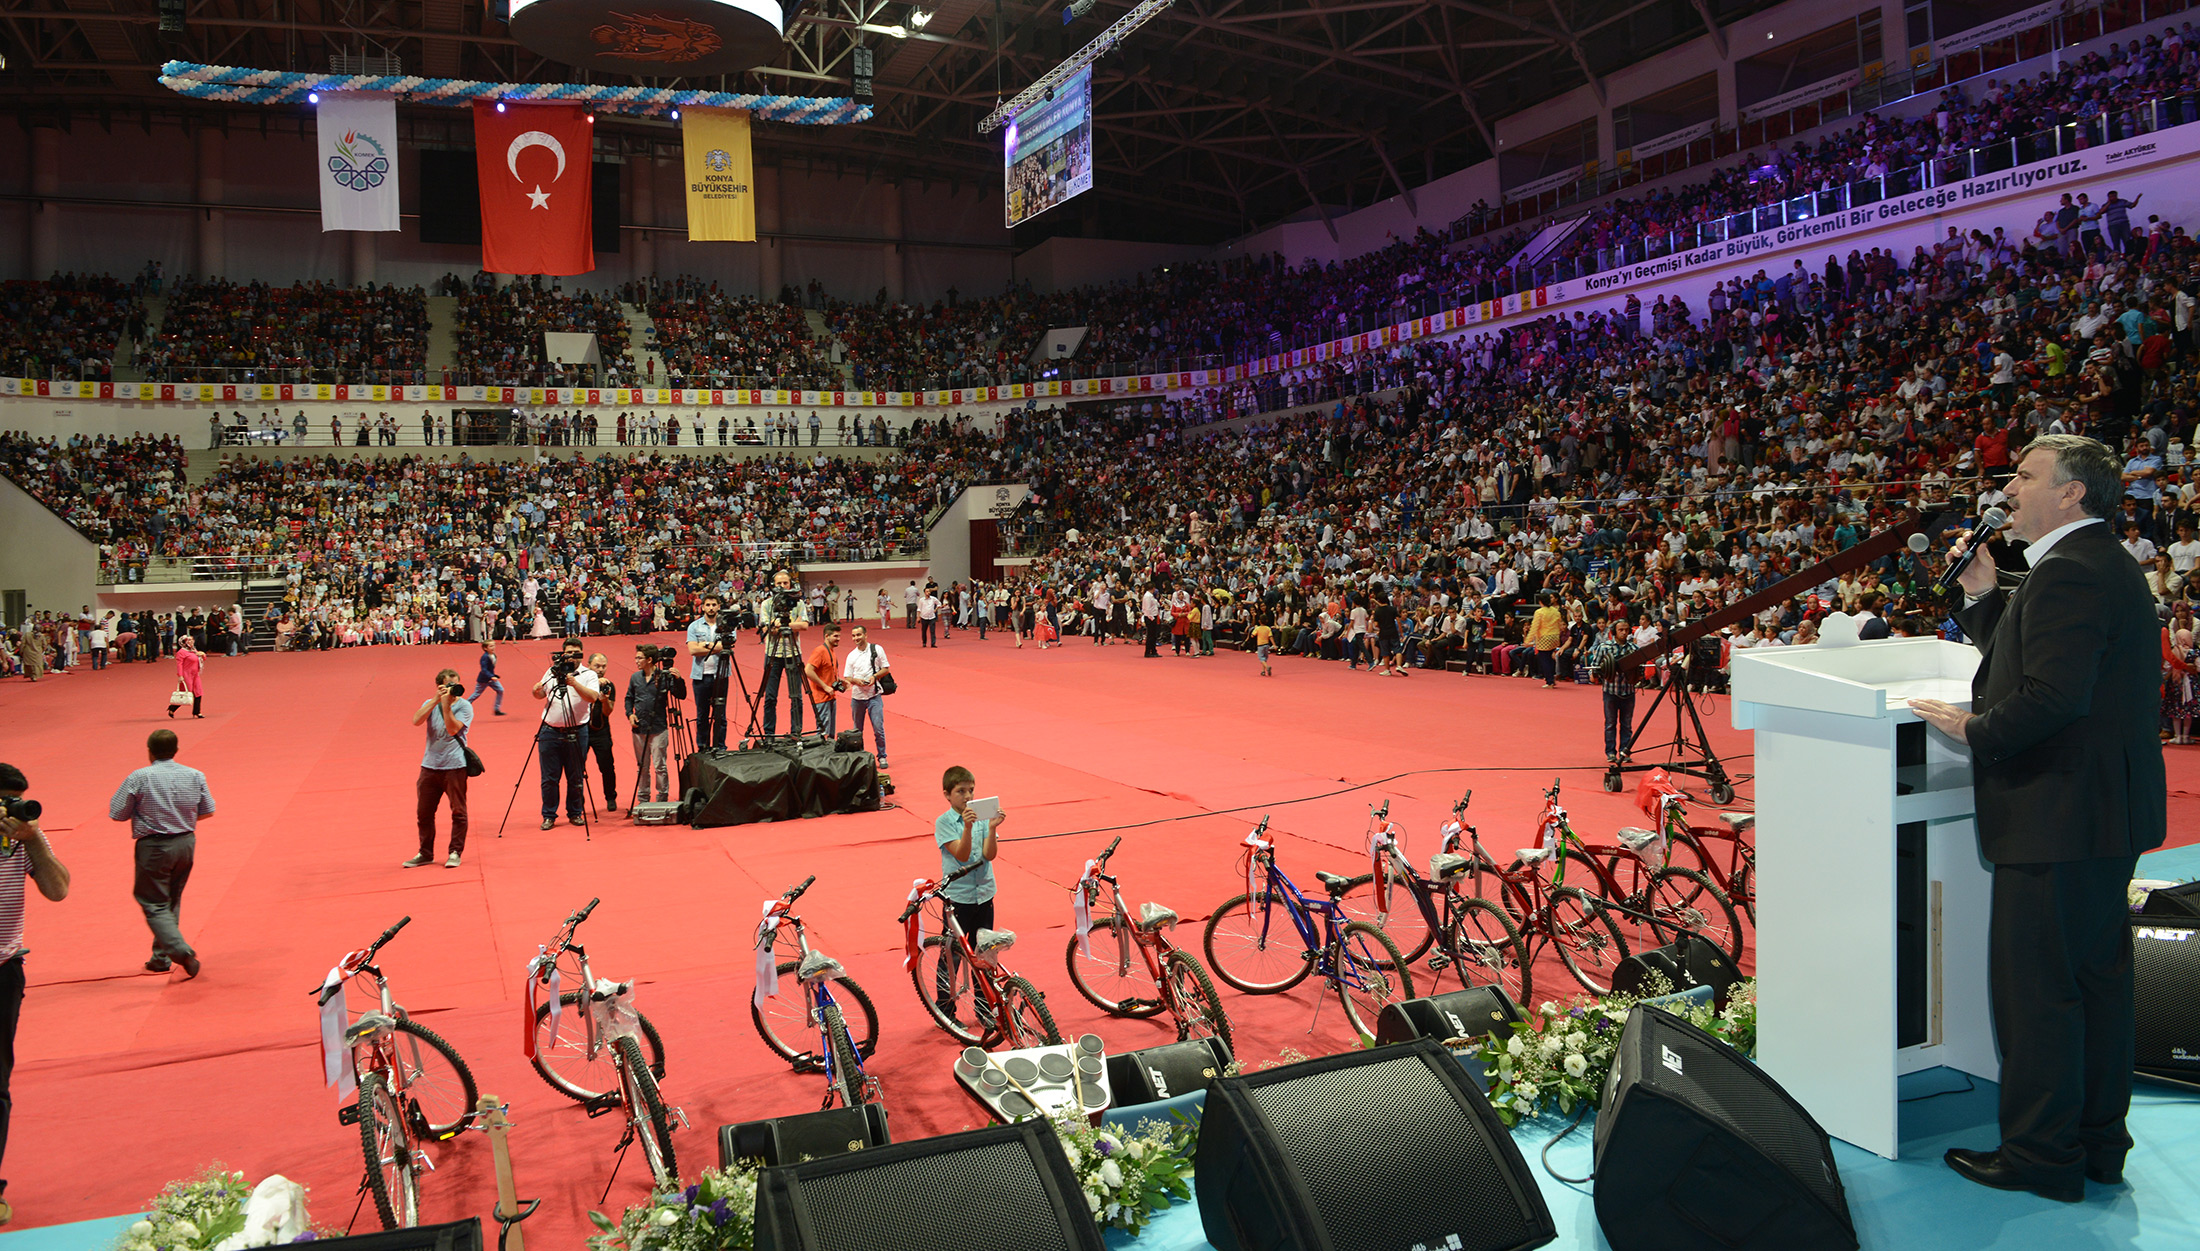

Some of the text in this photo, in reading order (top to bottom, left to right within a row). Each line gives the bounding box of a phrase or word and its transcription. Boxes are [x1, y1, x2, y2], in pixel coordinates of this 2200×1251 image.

[691, 182, 748, 193] BÜYÜKŞEHİR
[1635, 257, 1682, 277] Geçmişi
[1685, 247, 1723, 266] Kadar
[1726, 234, 1773, 257] Büyük,
[1777, 214, 1846, 244] Görkemli
[1850, 209, 1874, 226] Bir
[1878, 189, 1957, 219] Geleceğe
[1962, 158, 2087, 199] Hazırlıyoruz.
